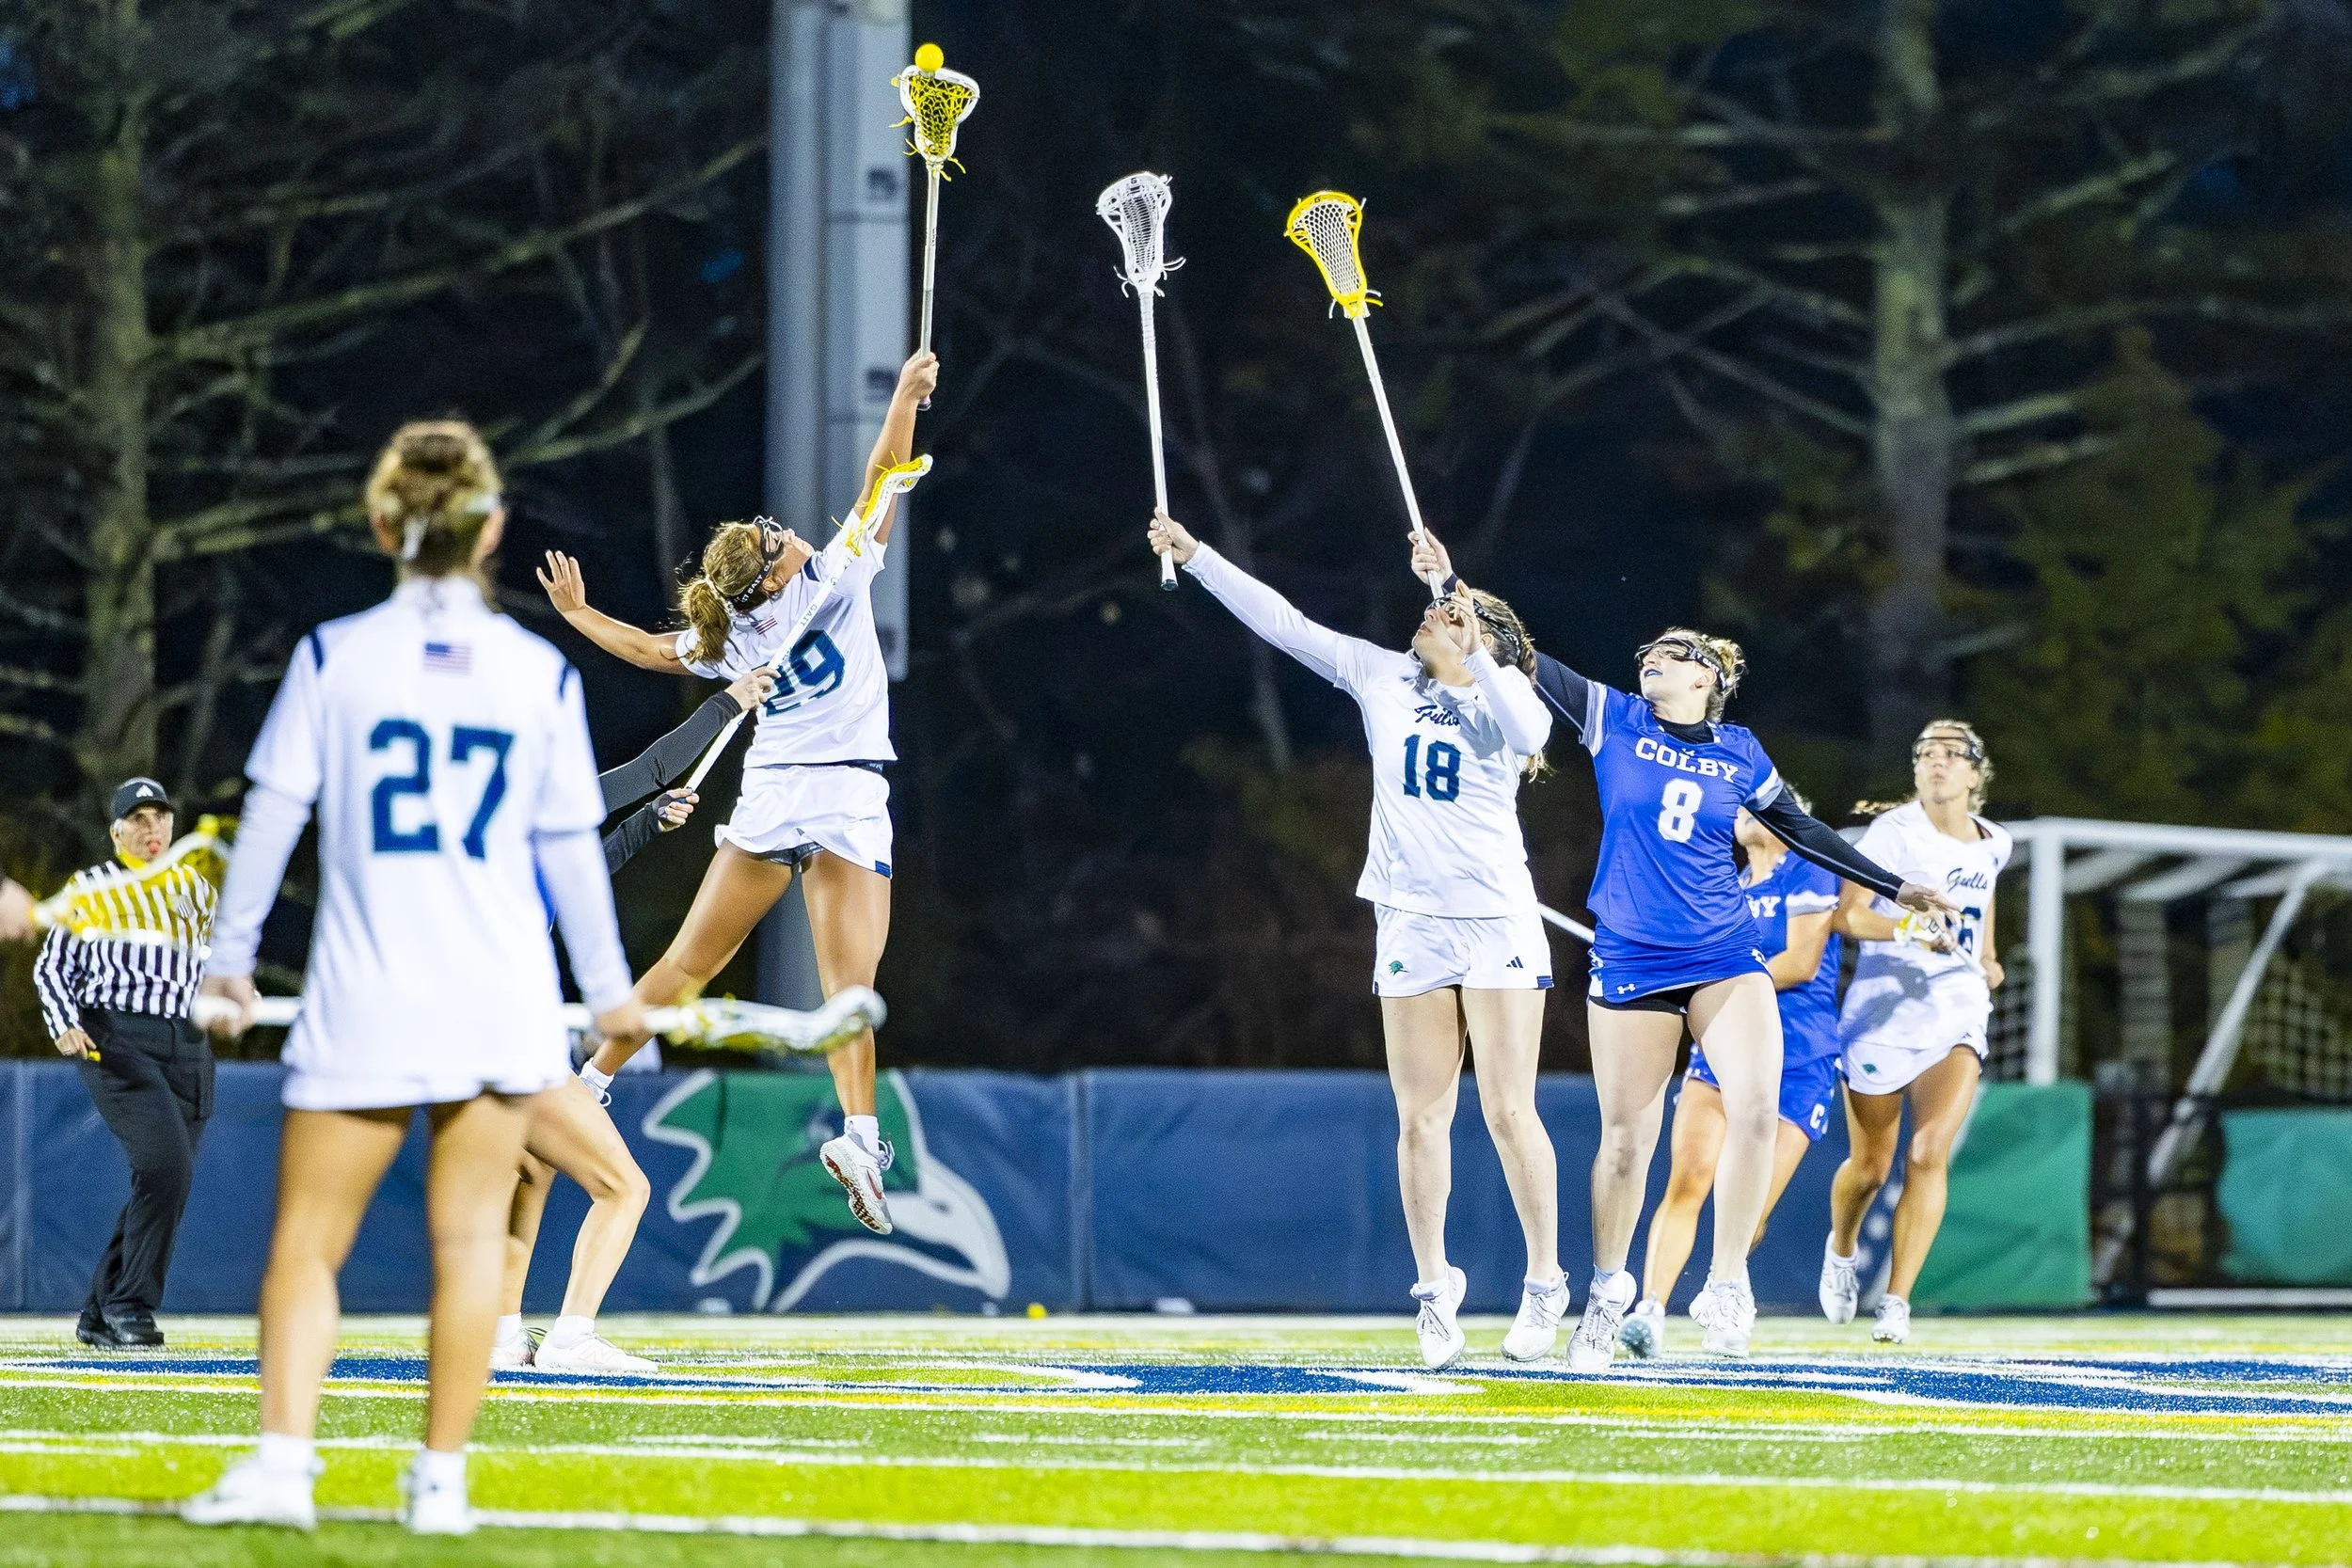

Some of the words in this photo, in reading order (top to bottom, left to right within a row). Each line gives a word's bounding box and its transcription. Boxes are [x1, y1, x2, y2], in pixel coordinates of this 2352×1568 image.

[747, 575, 764, 595] GAIT
[802, 604, 818, 627] GAIT
[1403, 734, 1461, 802] 18
[1635, 736, 1739, 783] COLBY
[370, 719, 515, 859] 27
[1658, 778, 1704, 844] 8
[1947, 867, 1988, 894] Gulls
